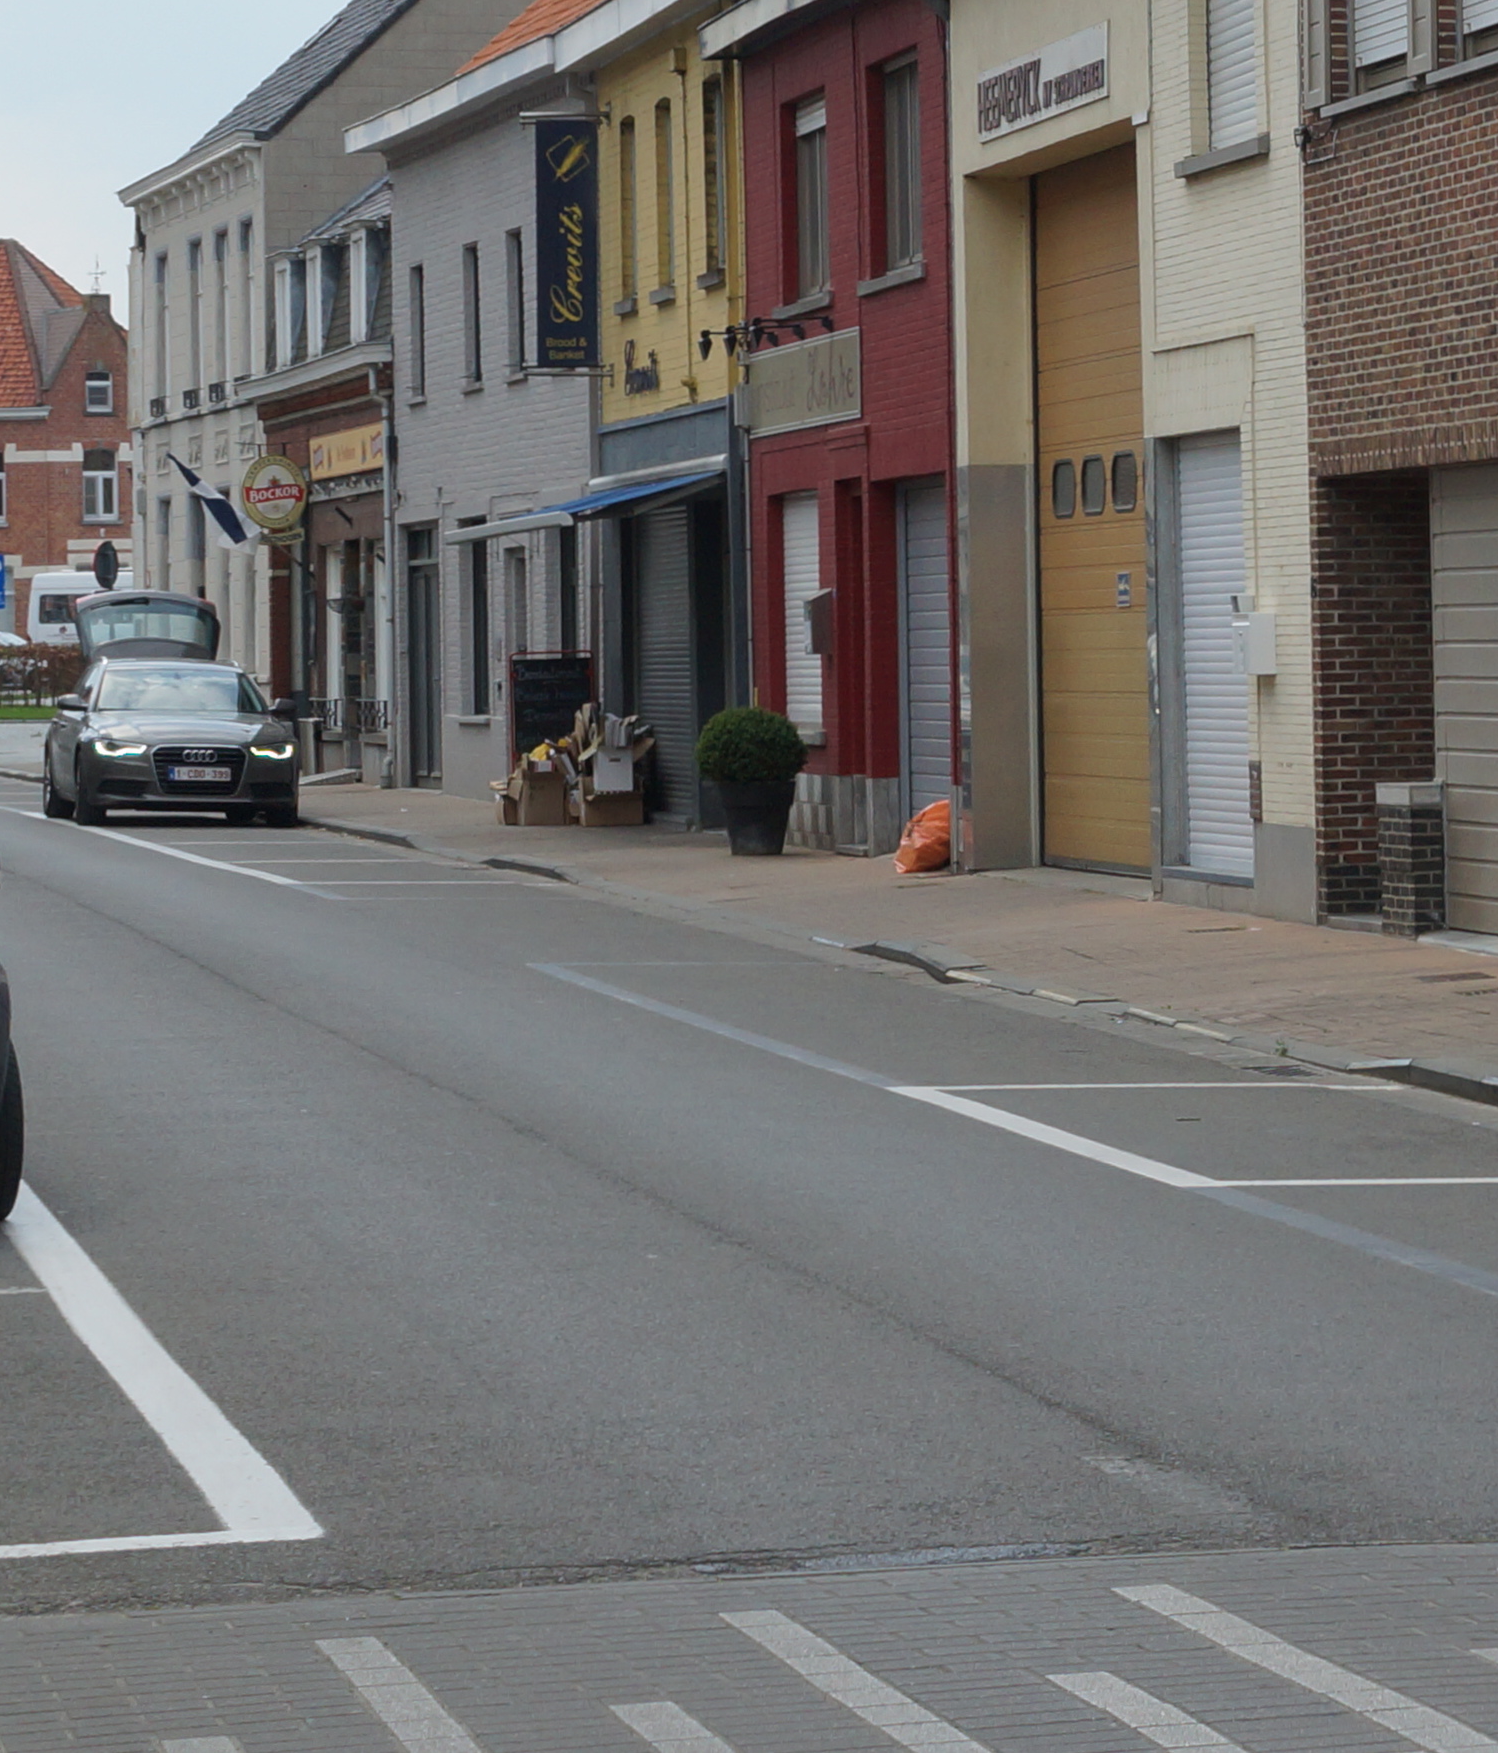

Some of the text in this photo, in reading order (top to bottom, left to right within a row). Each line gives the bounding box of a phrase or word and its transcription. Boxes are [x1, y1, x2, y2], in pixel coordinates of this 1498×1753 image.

[545, 337, 577, 347] Brood
[549, 349, 585, 360] Banket
[249, 486, 301, 503] BOCKOR
